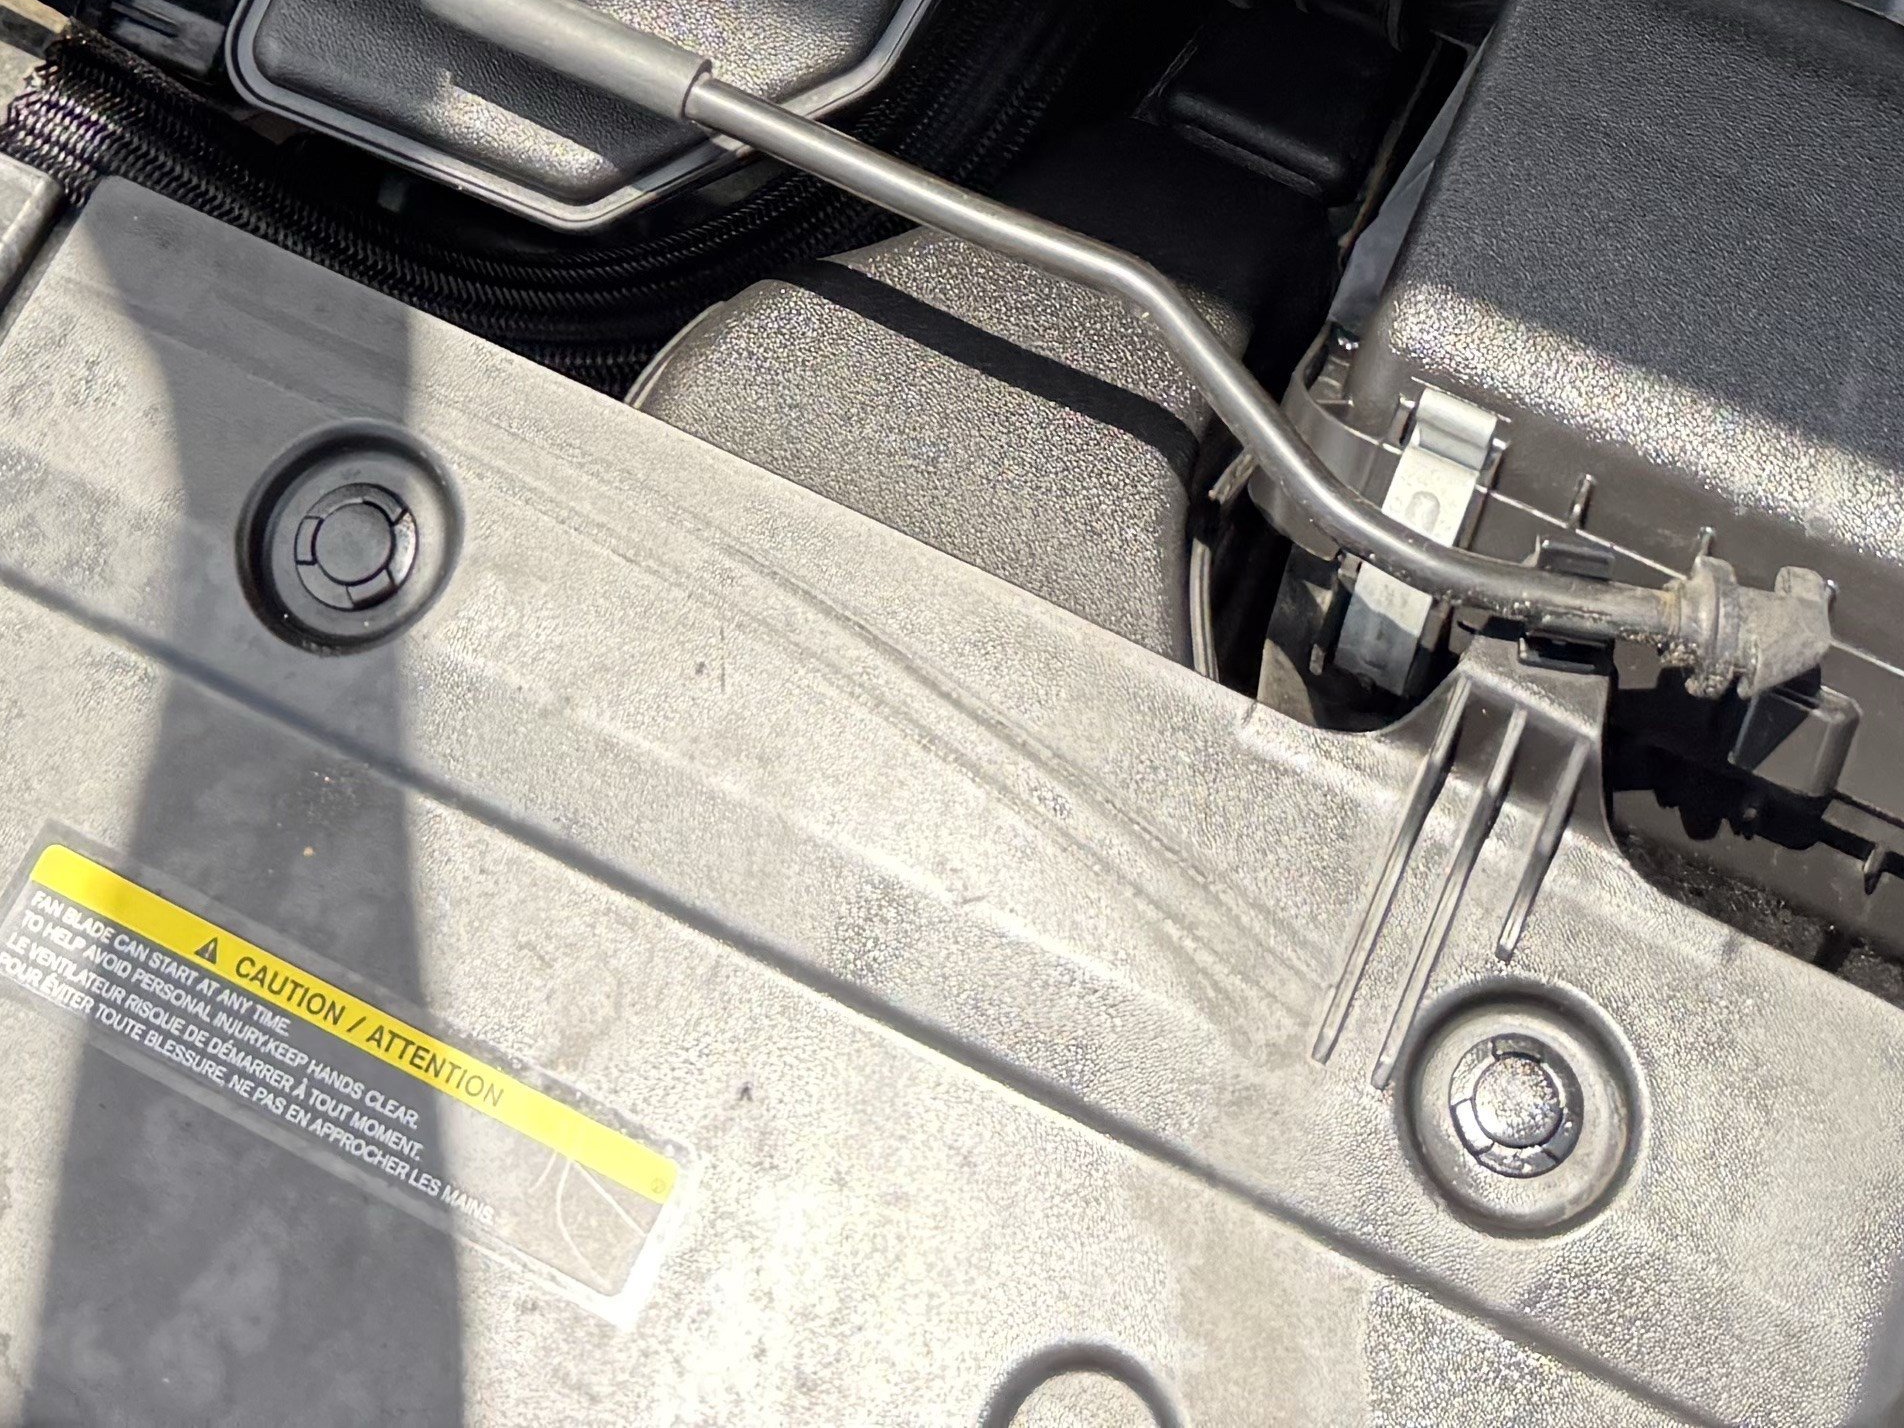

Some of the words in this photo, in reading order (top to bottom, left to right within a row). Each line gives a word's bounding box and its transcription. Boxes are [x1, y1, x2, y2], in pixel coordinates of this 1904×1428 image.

[5, 929, 30, 955] LE
[29, 941, 125, 1005] VENTILATEUR
[124, 990, 185, 1036] RISQUE
[182, 1020, 210, 1048] DE
[210, 1034, 294, 1092] DÉMARRER
[291, 1076, 311, 1101] À
[306, 1084, 352, 1122] TOUT
[350, 1107, 425, 1160] MOMENT.
[19, 909, 45, 935] TO
[41, 921, 86, 956] HELP
[82, 941, 132, 980] AVOID
[132, 967, 213, 1022] PERSONAL
[306, 1056, 365, 1100] HANDS
[363, 1086, 422, 1130] CLEAR.
[29, 889, 61, 918] FAN
[62, 906, 113, 945] BLADE
[112, 931, 148, 962] CAN
[148, 950, 198, 988] START
[195, 974, 220, 999] AT
[216, 984, 254, 1017] ANY
[251, 1002, 294, 1037] TIME.
[235, 954, 343, 1025] CAUTION
[346, 1010, 367, 1037] /
[368, 1021, 503, 1106] ATTENTION
[40, 973, 95, 1015] ÉVITER
[94, 1001, 145, 1042] TOUTE
[145, 1028, 229, 1085] BLESSURE,
[227, 1071, 256, 1100] NE
[251, 1083, 287, 1116] PAS
[284, 1100, 312, 1129] EN
[309, 1113, 408, 1179] APPROCHER
[407, 1164, 443, 1197] LES
[441, 1182, 501, 1228] MAINS.
